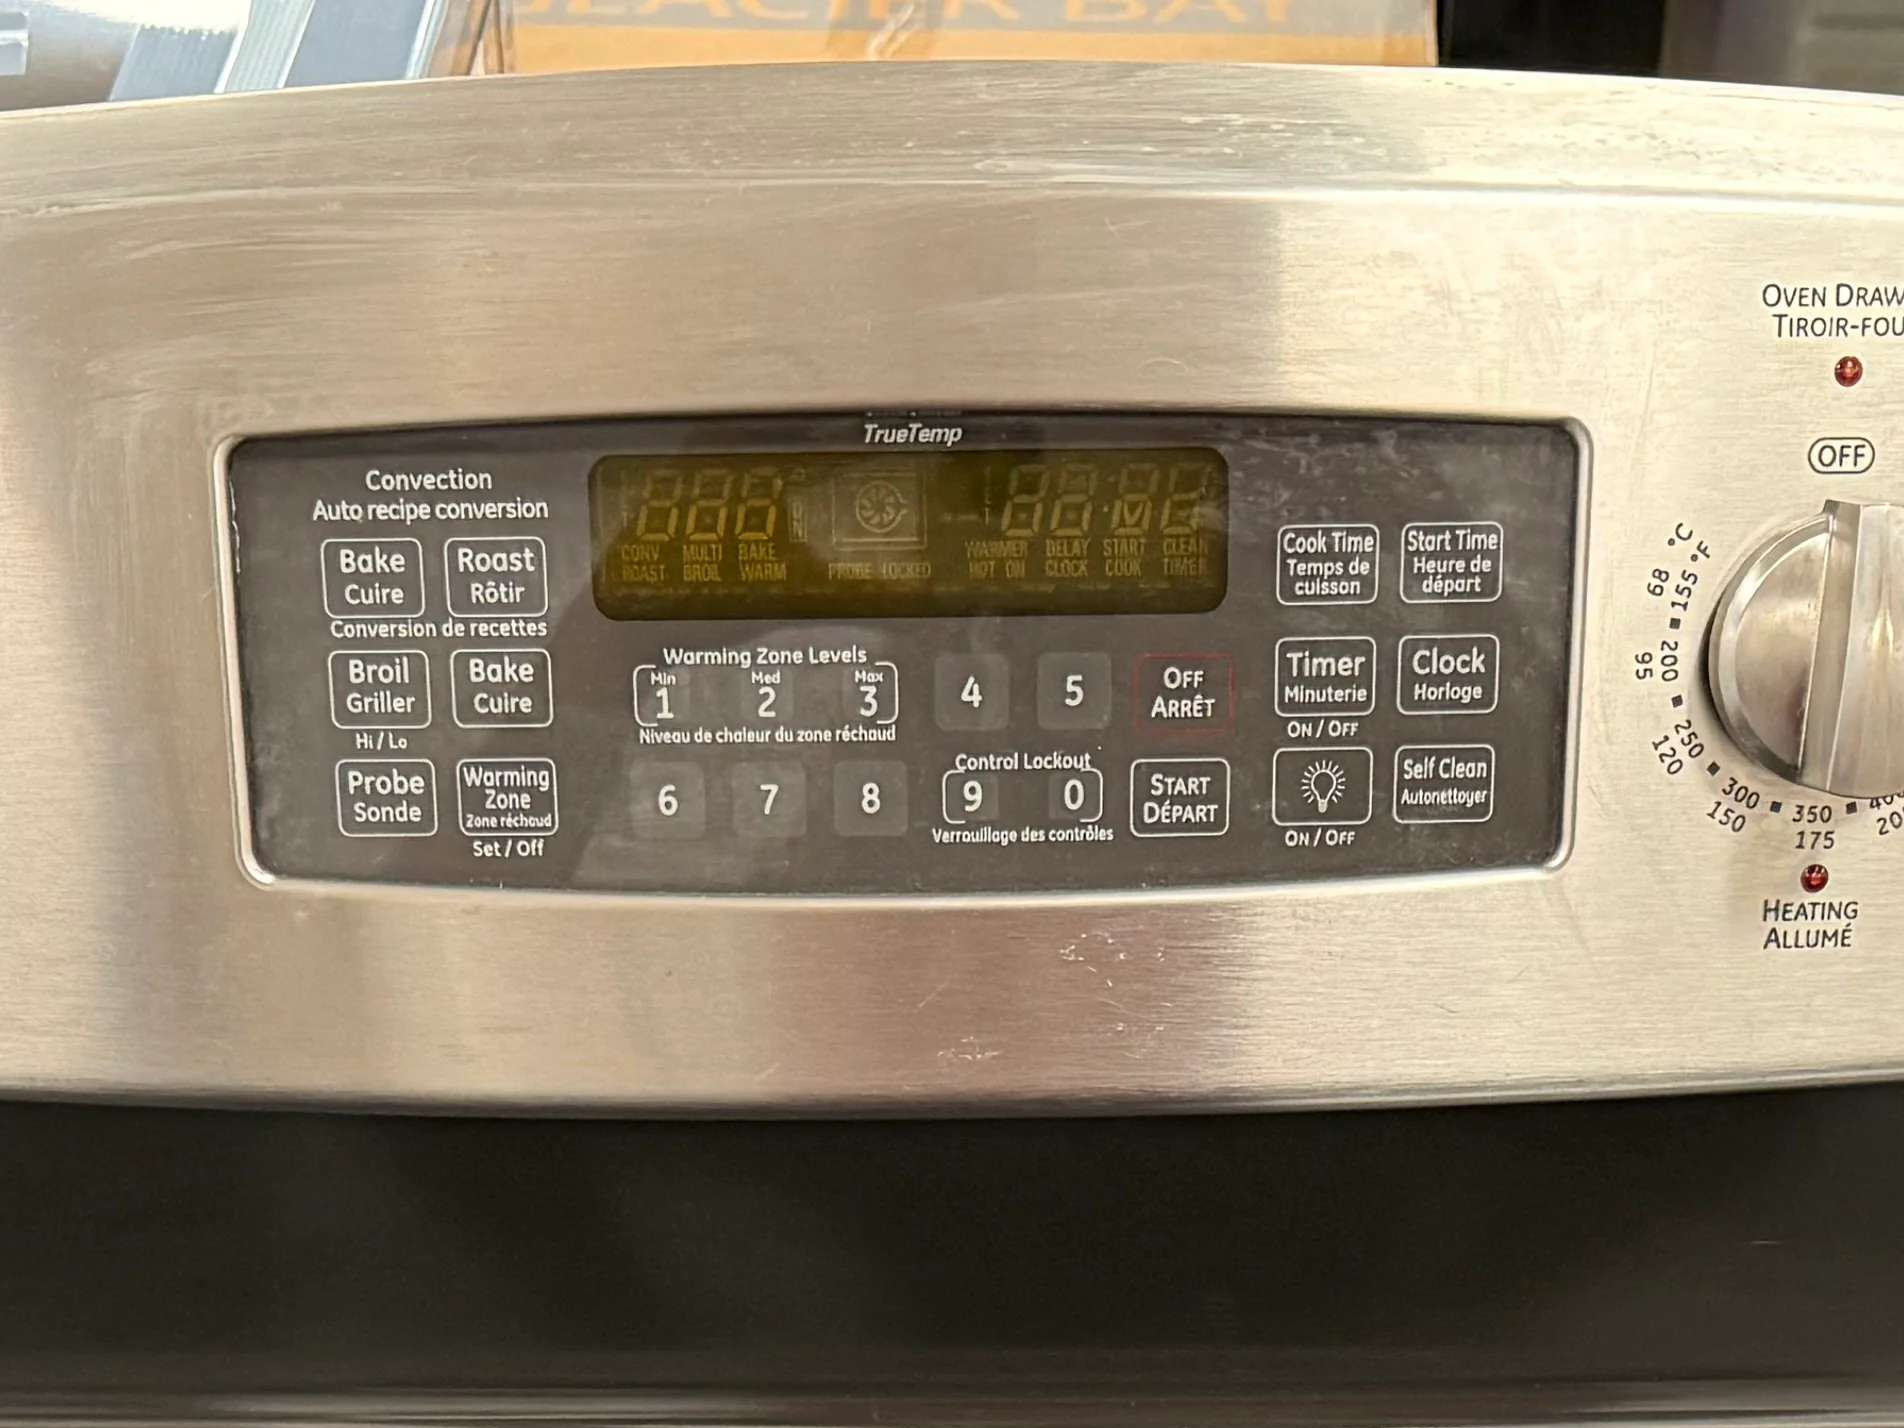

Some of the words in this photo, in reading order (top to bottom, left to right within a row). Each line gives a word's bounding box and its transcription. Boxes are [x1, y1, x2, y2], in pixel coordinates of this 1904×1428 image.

[1762, 283, 1827, 308] OVEN
[864, 422, 963, 448] TrueTemp
[1817, 443, 1866, 468] OFF
[365, 467, 493, 491] Convection
[312, 499, 364, 523] Auto
[367, 497, 431, 526] recipe
[434, 496, 549, 520] conversion
[1283, 529, 1327, 554] Cook
[1331, 530, 1375, 553] Time
[1407, 529, 1452, 552] Start
[1455, 527, 1499, 551] Time
[339, 545, 405, 574] Bake
[457, 547, 536, 573] Roast
[1286, 558, 1344, 580] Temps
[1348, 555, 1370, 576] de
[1413, 555, 1466, 574] Heure
[1470, 553, 1492, 573] de
[344, 582, 404, 605] Cuire
[470, 580, 526, 604] Rôtir
[1294, 577, 1361, 596] cuisson
[1421, 573, 1482, 597] départ
[330, 618, 437, 639] Conversion
[441, 617, 465, 637] de
[469, 618, 548, 637] recettes
[469, 655, 534, 683] Bake
[663, 647, 752, 669] Warming
[756, 647, 804, 665] Zone
[808, 644, 867, 664] Levels
[1286, 650, 1366, 678] Timer
[1412, 645, 1486, 675] Clock
[1660, 639, 1679, 682] 200
[348, 655, 410, 684] Broil
[651, 671, 676, 685] Min
[752, 671, 780, 685] Med
[854, 670, 883, 684] Max
[1163, 666, 1204, 690] OFF
[346, 690, 416, 714] Griller
[473, 691, 533, 714] Cuire
[656, 686, 675, 719] 1
[757, 685, 776, 718] 2
[859, 685, 878, 717] 3
[960, 675, 983, 708] 4
[1064, 674, 1084, 707] 5
[1284, 683, 1368, 704] Minuterie
[1414, 681, 1483, 704] Horloge
[1150, 693, 1216, 719] ARRÊT
[356, 733, 374, 750] Hi
[388, 731, 408, 750] Lo
[640, 728, 689, 744] Niveau
[694, 726, 713, 743] de
[715, 726, 772, 744] chaleur
[774, 725, 794, 743] du
[796, 729, 832, 742] zone
[835, 727, 896, 742] réchaud
[1287, 720, 1313, 738] ON
[1328, 719, 1359, 737] OFF
[956, 753, 1018, 770] Control
[1023, 753, 1091, 770] Lockout
[1403, 758, 1434, 780] Self
[1438, 755, 1488, 779] Clean
[347, 768, 425, 795] Probe
[462, 764, 550, 792] Warming
[1150, 773, 1211, 796] START
[484, 788, 531, 810] Zone
[658, 784, 678, 816] 6
[760, 783, 779, 815] 7
[861, 782, 881, 814] 8
[963, 780, 983, 812] 9
[1064, 778, 1085, 811] 0
[1400, 787, 1488, 808] Autonettoyer
[1721, 776, 1761, 810] 300
[353, 799, 422, 823] Sonde
[466, 814, 496, 828] Zone
[498, 813, 551, 827] réchaud
[1143, 798, 1219, 824] DÉPART
[1706, 800, 1747, 833] 150
[1791, 804, 1833, 824] 350
[472, 840, 502, 857] Set
[516, 838, 545, 857] Off
[931, 826, 1018, 847] Verrouillage
[1020, 826, 1046, 842] des
[1048, 824, 1114, 842] contrôles
[1284, 829, 1310, 847] ON
[1325, 829, 1356, 846] OFF
[1794, 830, 1835, 850] 175
[1762, 898, 1859, 923] HEATING
[1764, 923, 1853, 949] ALLUMÉ
